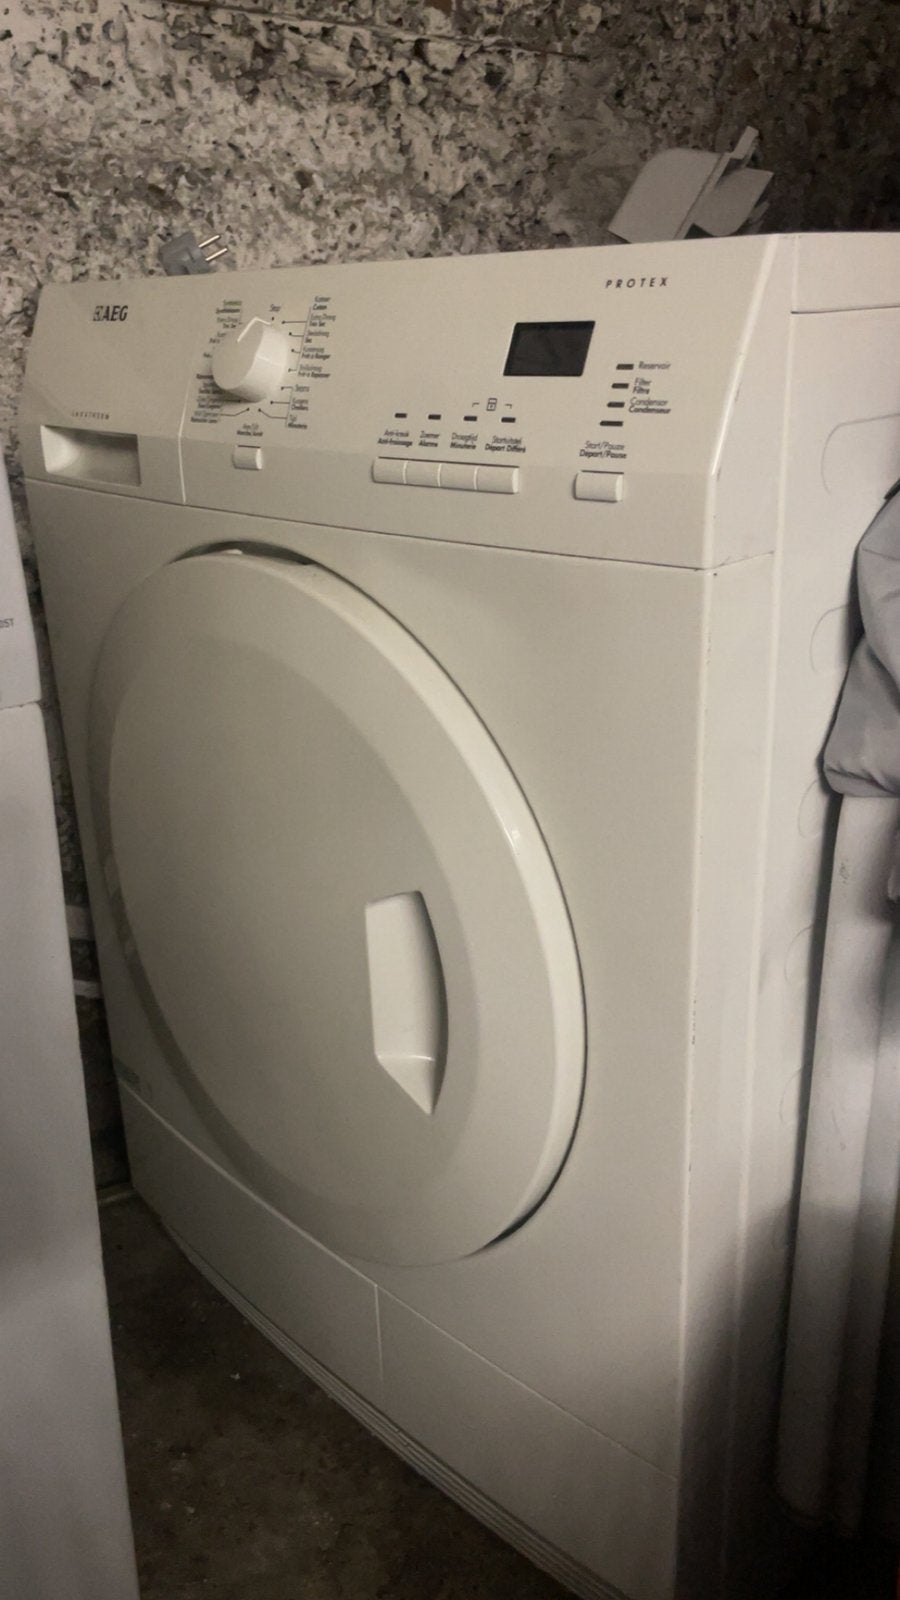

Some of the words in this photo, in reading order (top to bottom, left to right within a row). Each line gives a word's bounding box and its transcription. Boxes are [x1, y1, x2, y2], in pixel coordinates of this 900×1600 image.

[604, 276, 670, 289] PROTEX
[102, 305, 128, 322] AEG
[638, 361, 671, 370] Reservoir
